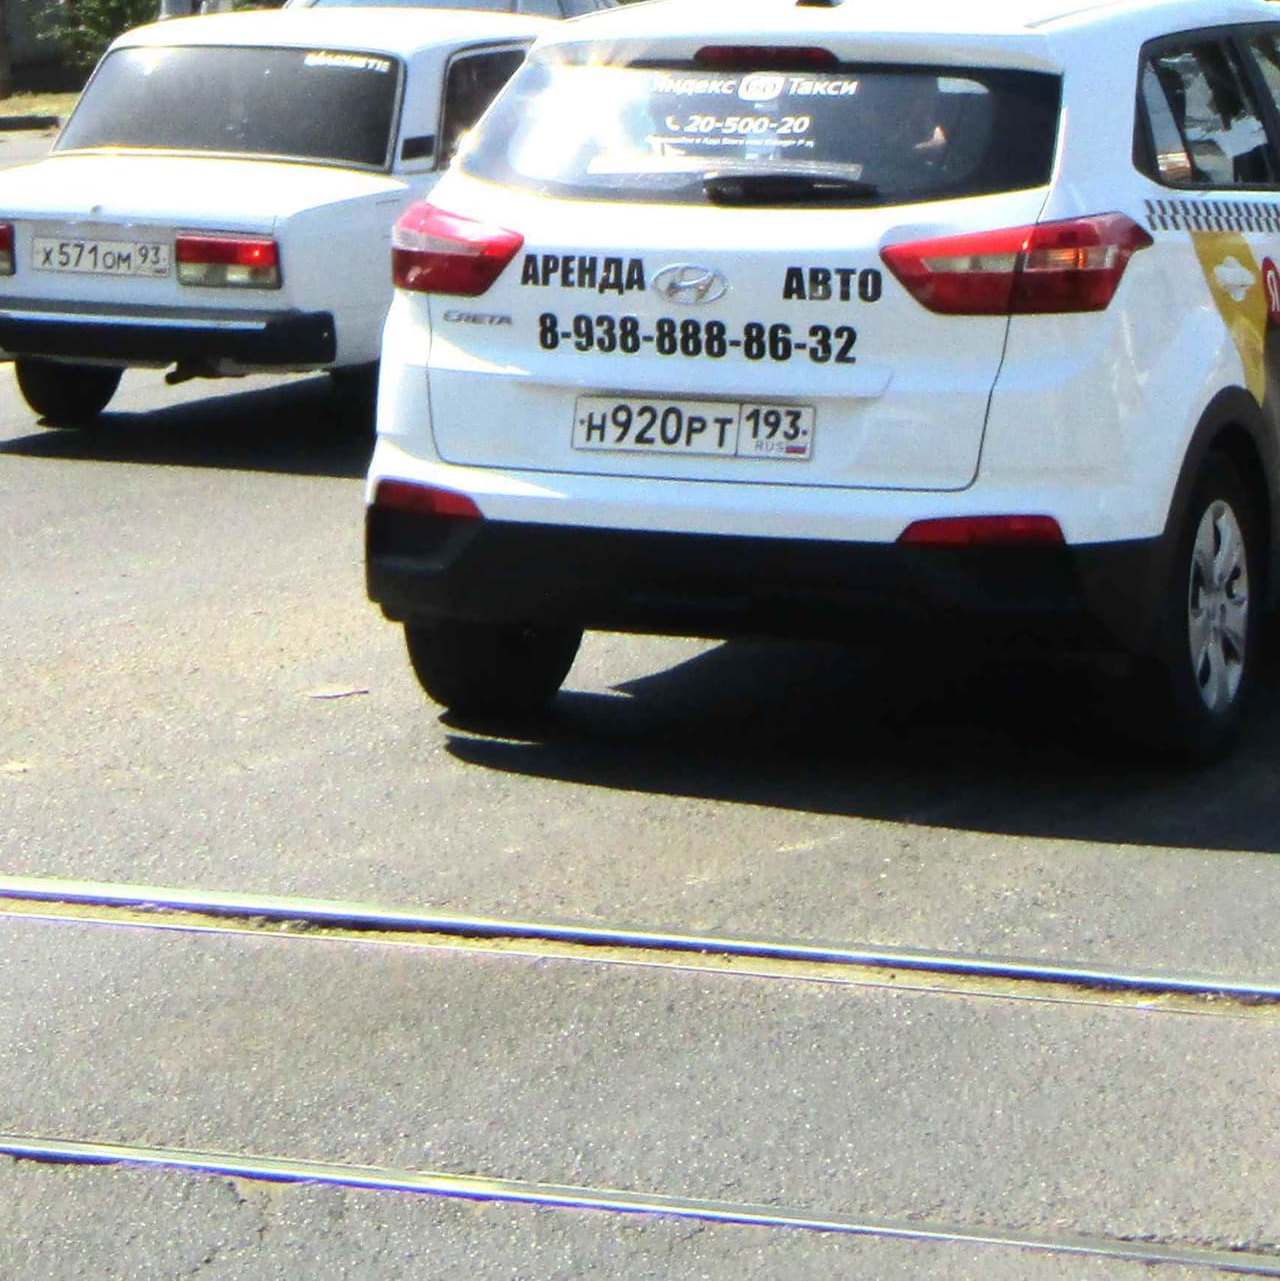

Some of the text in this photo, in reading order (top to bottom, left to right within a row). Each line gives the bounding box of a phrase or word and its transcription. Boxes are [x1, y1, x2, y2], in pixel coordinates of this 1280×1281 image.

[788, 77, 859, 96] Такси
[683, 115, 810, 134] 20-500-20
[138, 245, 160, 264] 93
[520, 253, 883, 302] АРЕНДА АВТО
[537, 312, 858, 365] 8-938-888-86-32
[745, 408, 802, 441] 193
